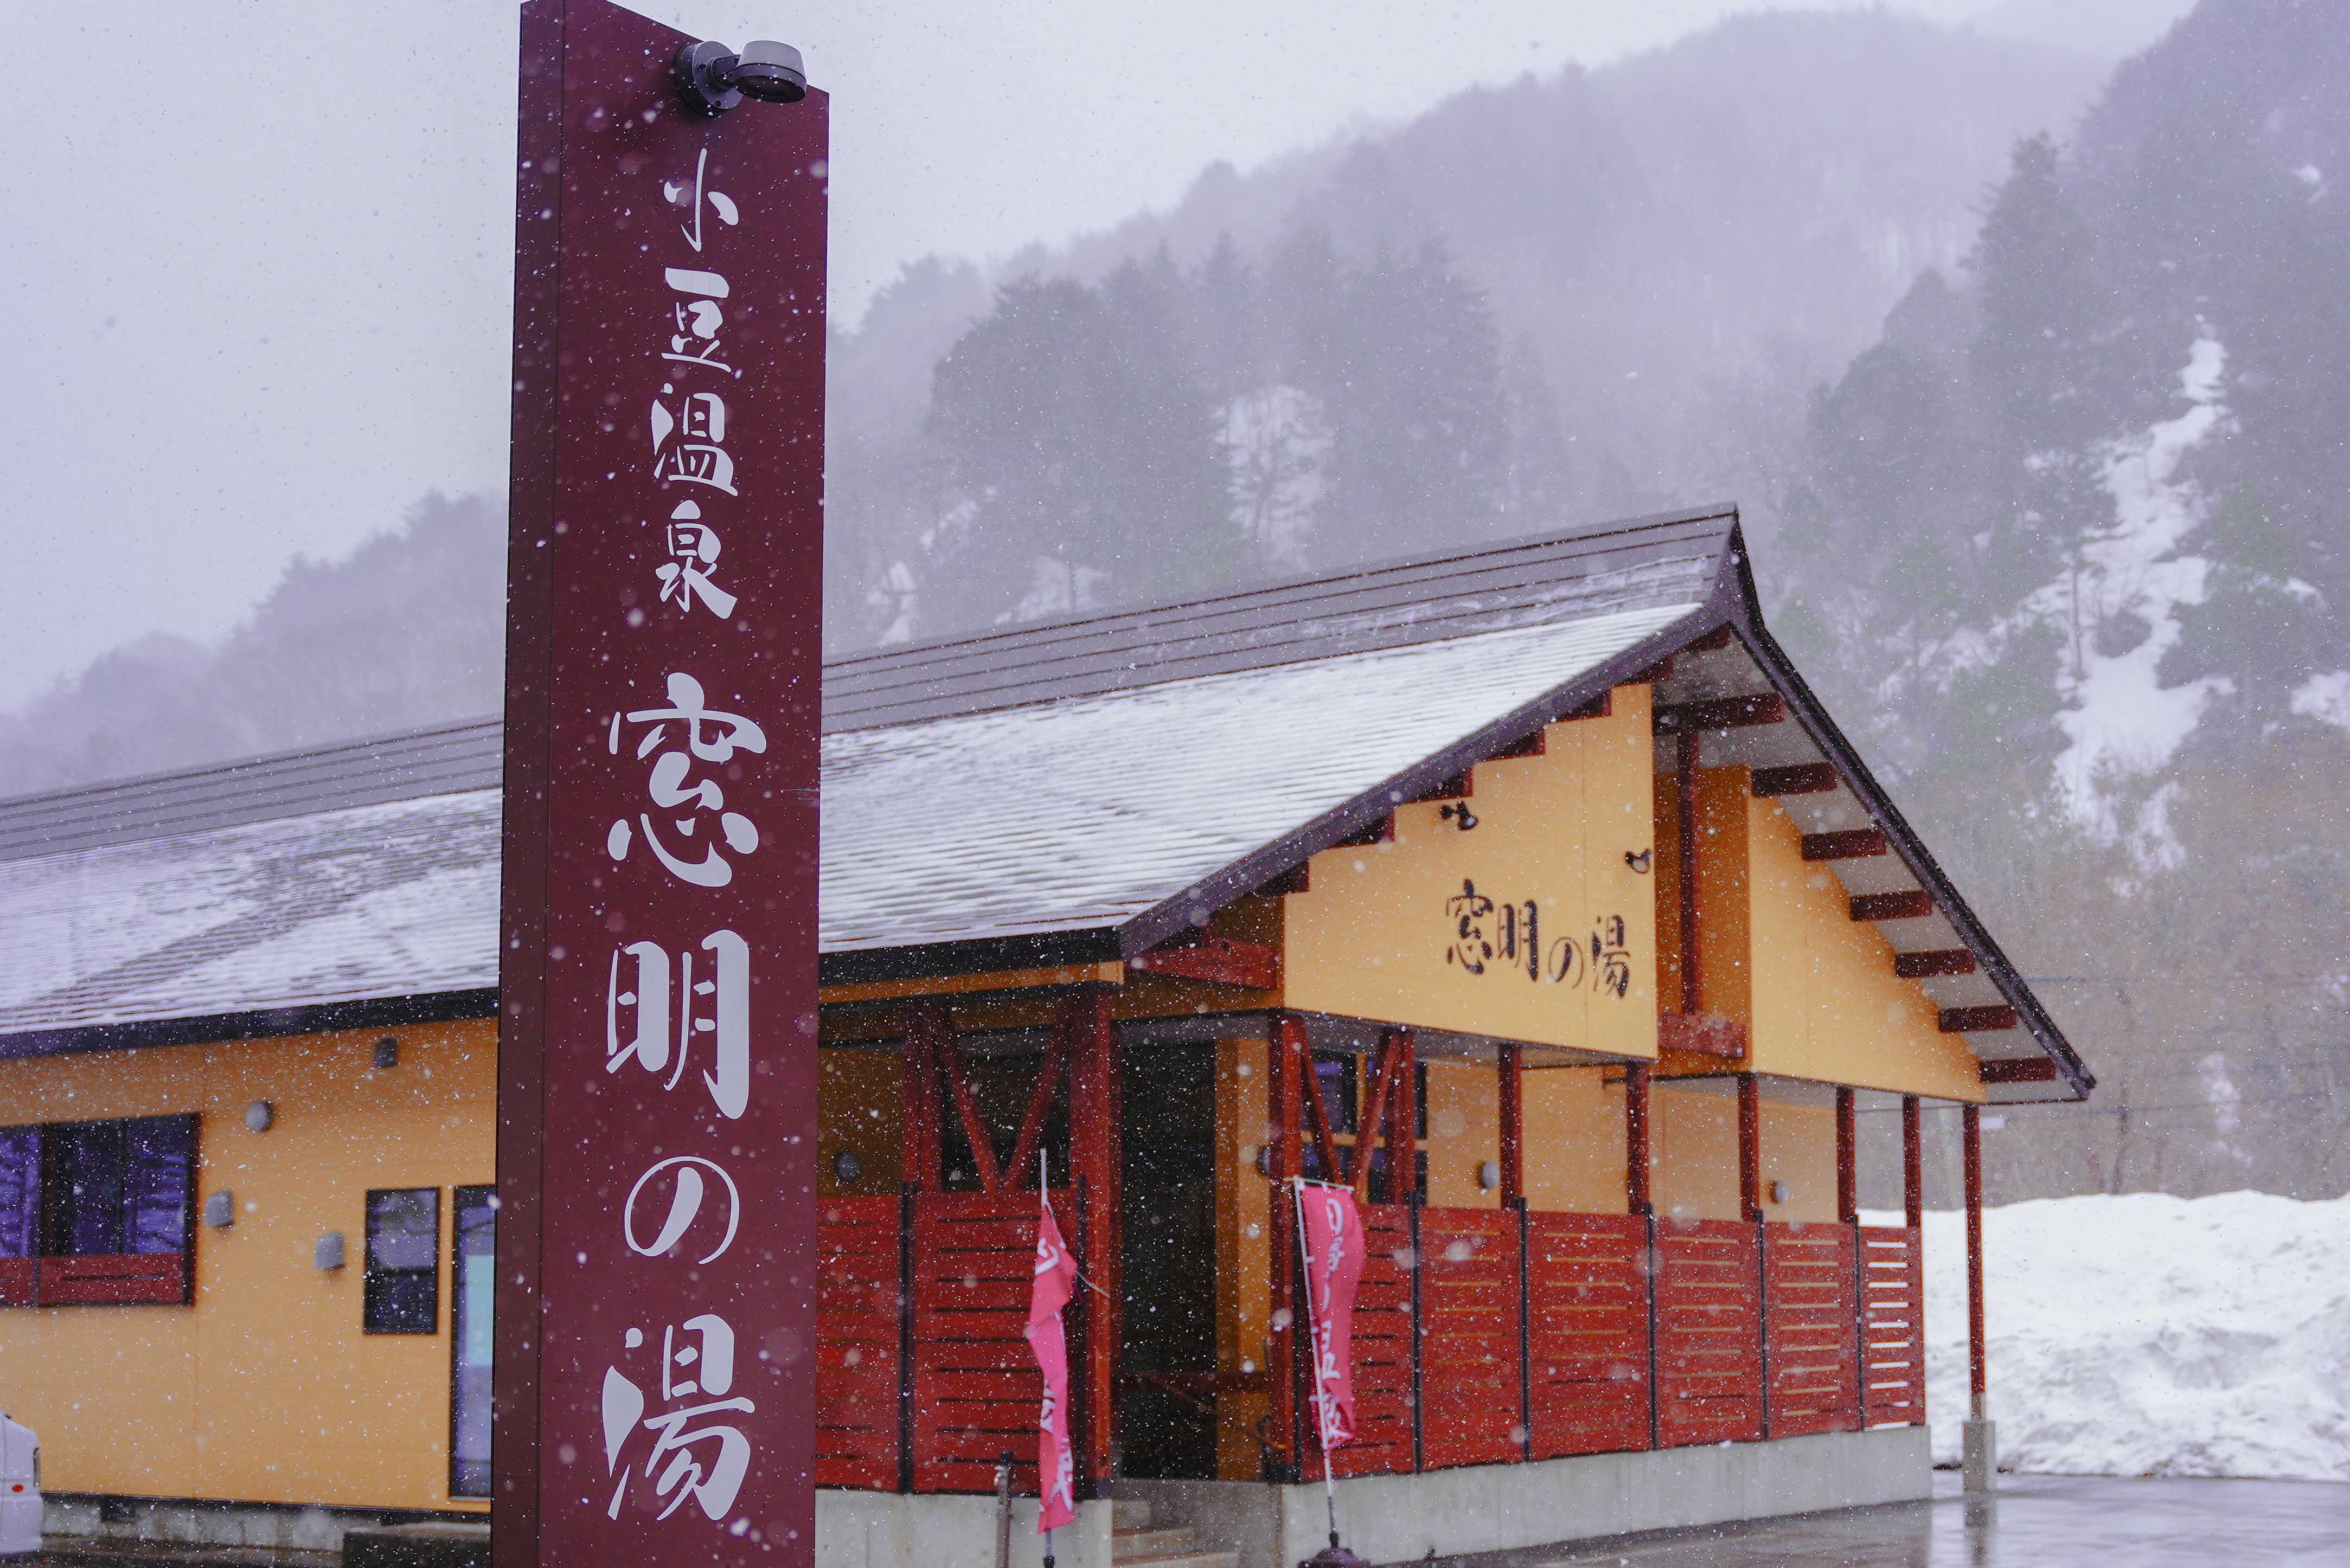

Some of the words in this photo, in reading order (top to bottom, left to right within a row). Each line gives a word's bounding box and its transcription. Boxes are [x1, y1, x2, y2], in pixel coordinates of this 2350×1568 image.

[651, 148, 739, 619] 小豆温泉
[602, 672, 766, 1521] 窓明の湯
[1445, 878, 1630, 999] 窓明の湯
